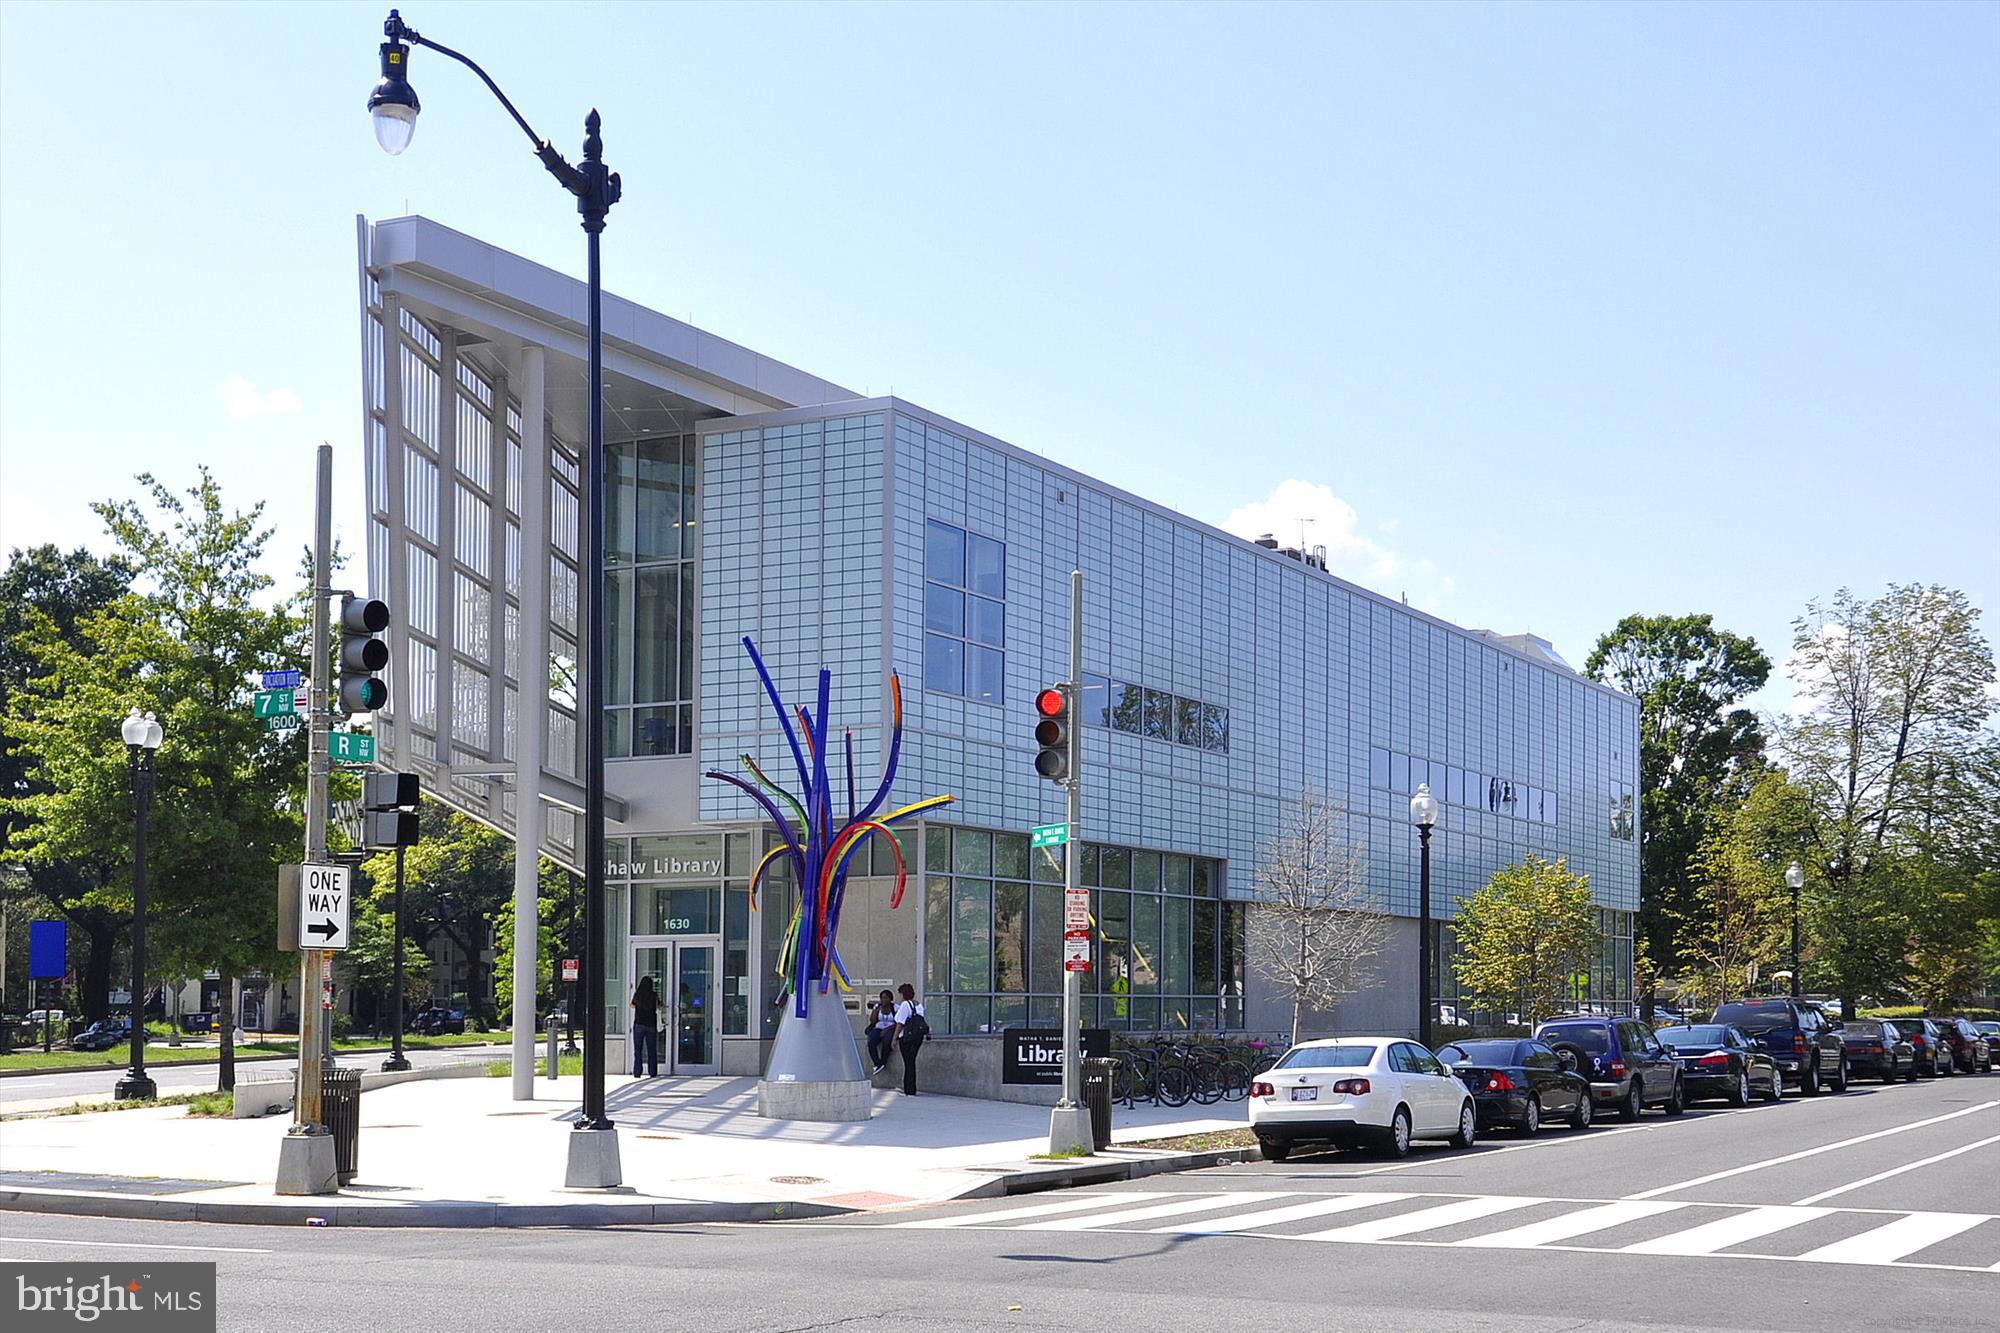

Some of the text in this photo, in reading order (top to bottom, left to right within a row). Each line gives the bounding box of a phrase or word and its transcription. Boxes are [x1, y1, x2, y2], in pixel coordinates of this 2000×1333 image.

[260, 694, 289, 714] 7 ST
[268, 715, 296, 729] 1600
[338, 735, 370, 755] R ST
[654, 858, 721, 876] Library
[310, 871, 341, 891] ONE
[308, 893, 342, 913] WAY
[663, 918, 690, 930] 1630
[1018, 1044, 1088, 1063] Libray
